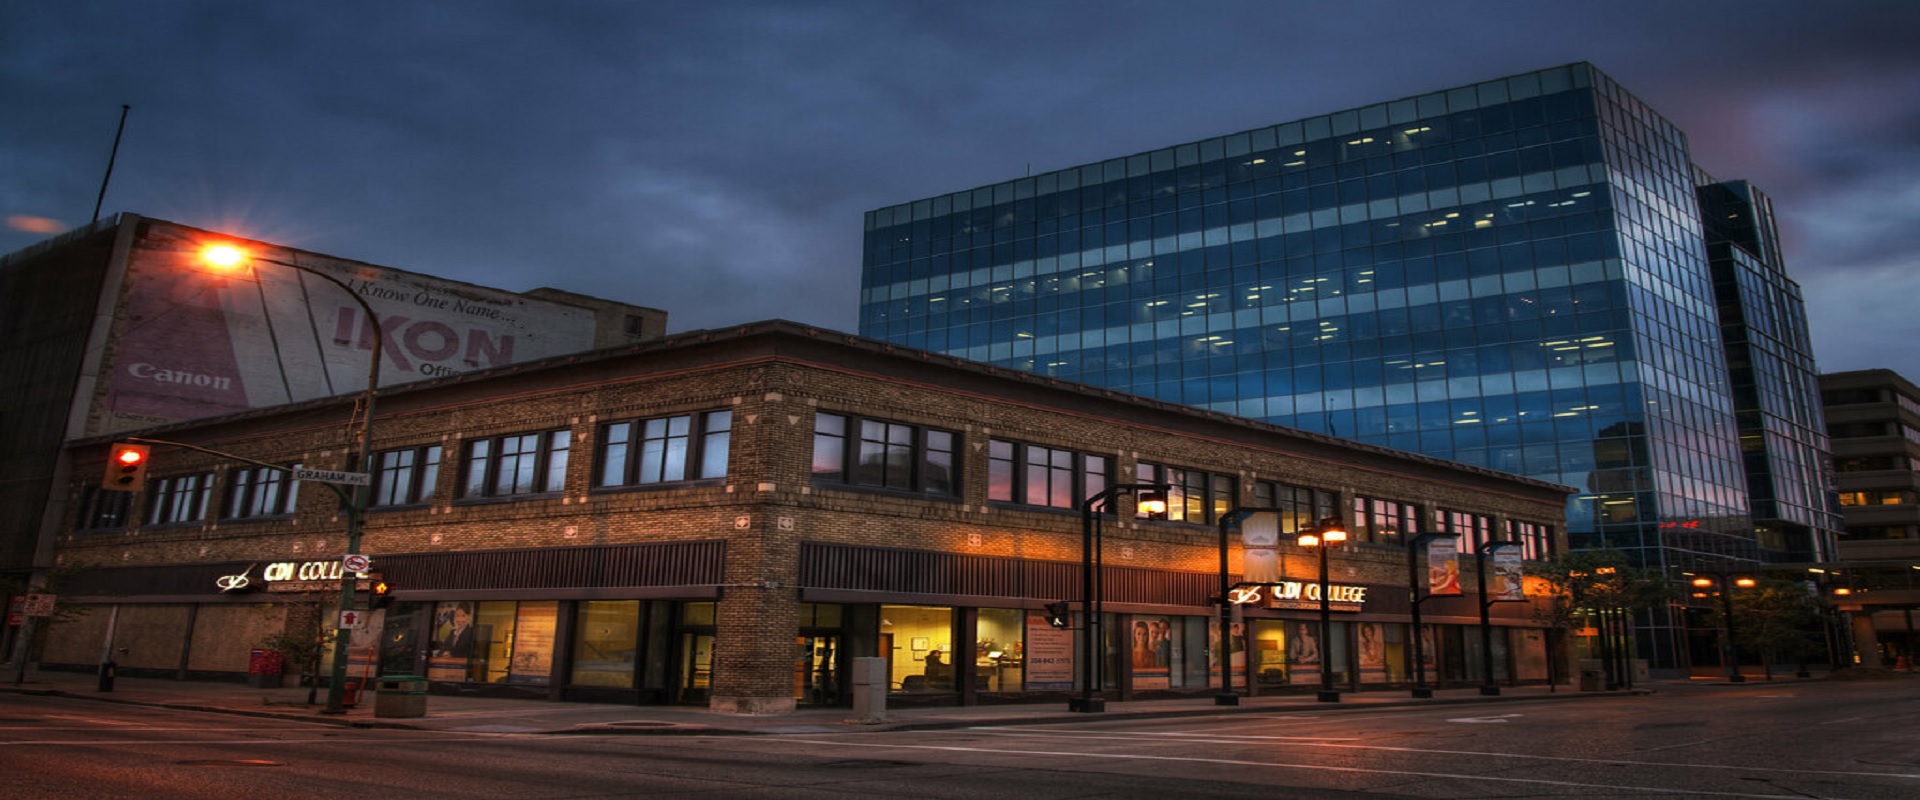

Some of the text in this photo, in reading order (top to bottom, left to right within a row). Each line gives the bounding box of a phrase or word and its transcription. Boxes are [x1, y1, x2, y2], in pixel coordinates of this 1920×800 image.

[358, 281, 410, 303] Know
[413, 292, 449, 310] One
[333, 306, 515, 373] IKON
[128, 362, 232, 390] Canon
[297, 470, 346, 482] GRAHAM
[263, 562, 296, 581] CDI
[1274, 581, 1302, 599] CDI
